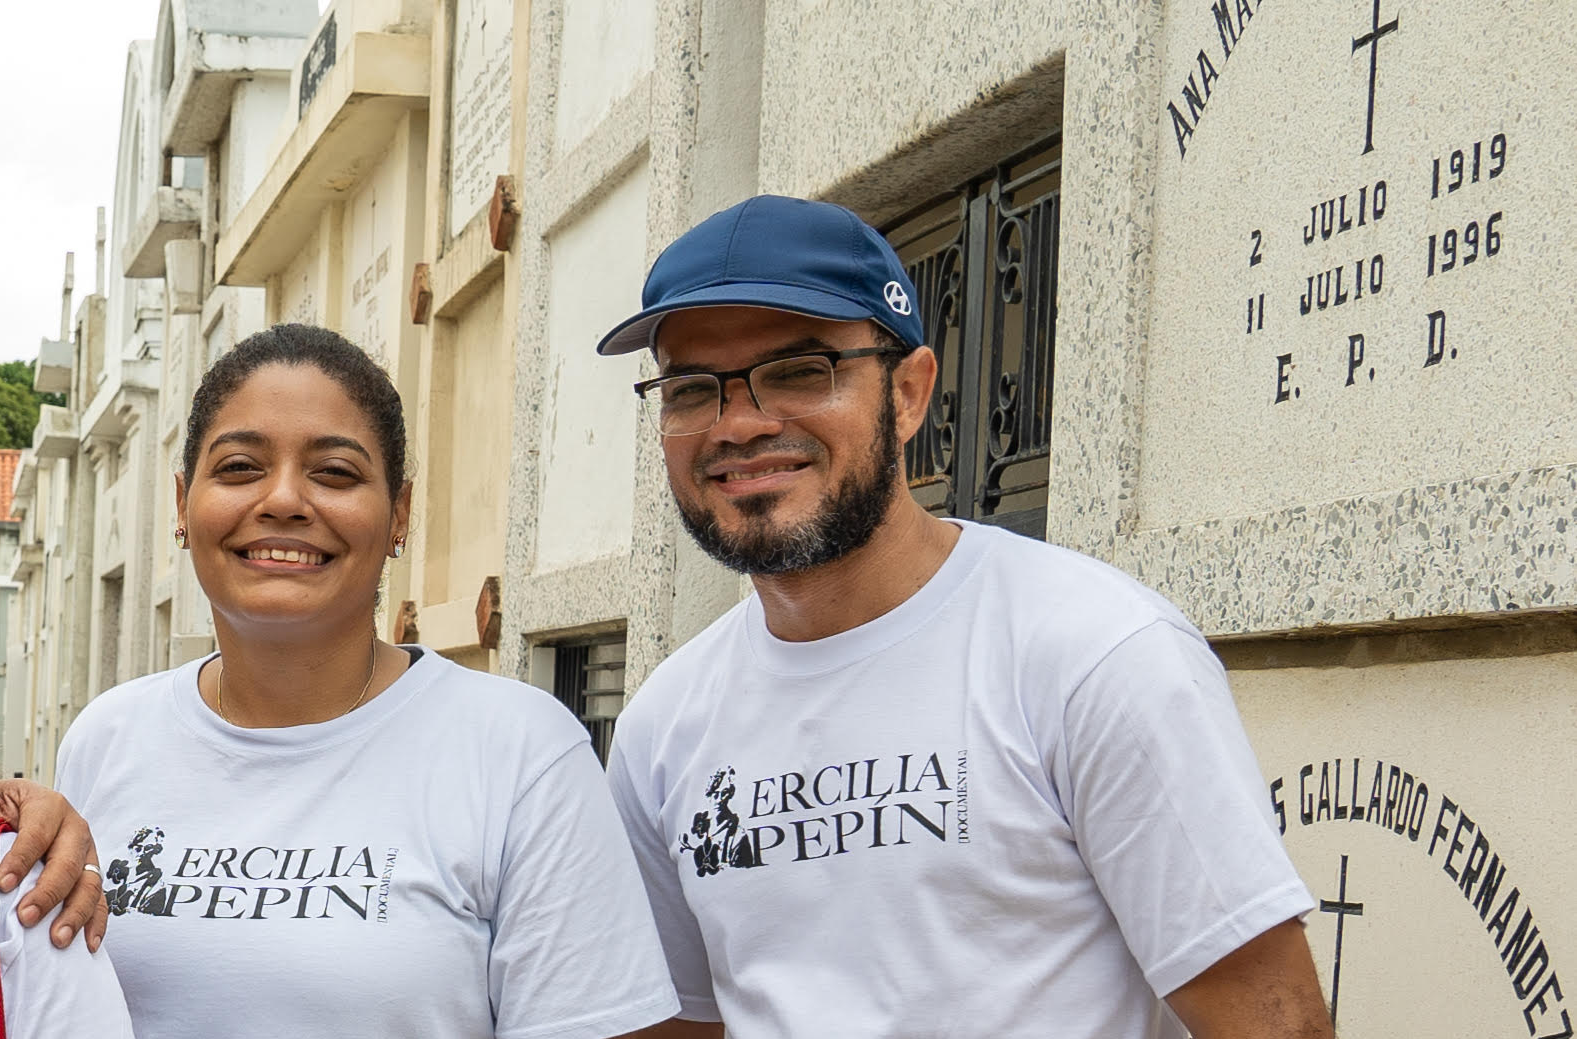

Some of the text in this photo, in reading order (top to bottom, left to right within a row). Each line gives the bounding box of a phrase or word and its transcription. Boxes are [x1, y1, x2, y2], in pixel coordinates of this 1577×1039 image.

[1167, 0, 1262, 160] ANA MA
[1250, 133, 1507, 266] 2 JULIO 1919
[1300, 254, 1383, 315] JULIO
[1427, 212, 1503, 277] 1996
[1274, 310, 1457, 404] E. P. D.
[748, 752, 952, 818] ERCILIA
[1300, 758, 1428, 841] GALLARDO
[172, 845, 378, 880] ERCILIA
[748, 794, 954, 867] PEPÍN
[163, 876, 378, 920] PEPÍN
